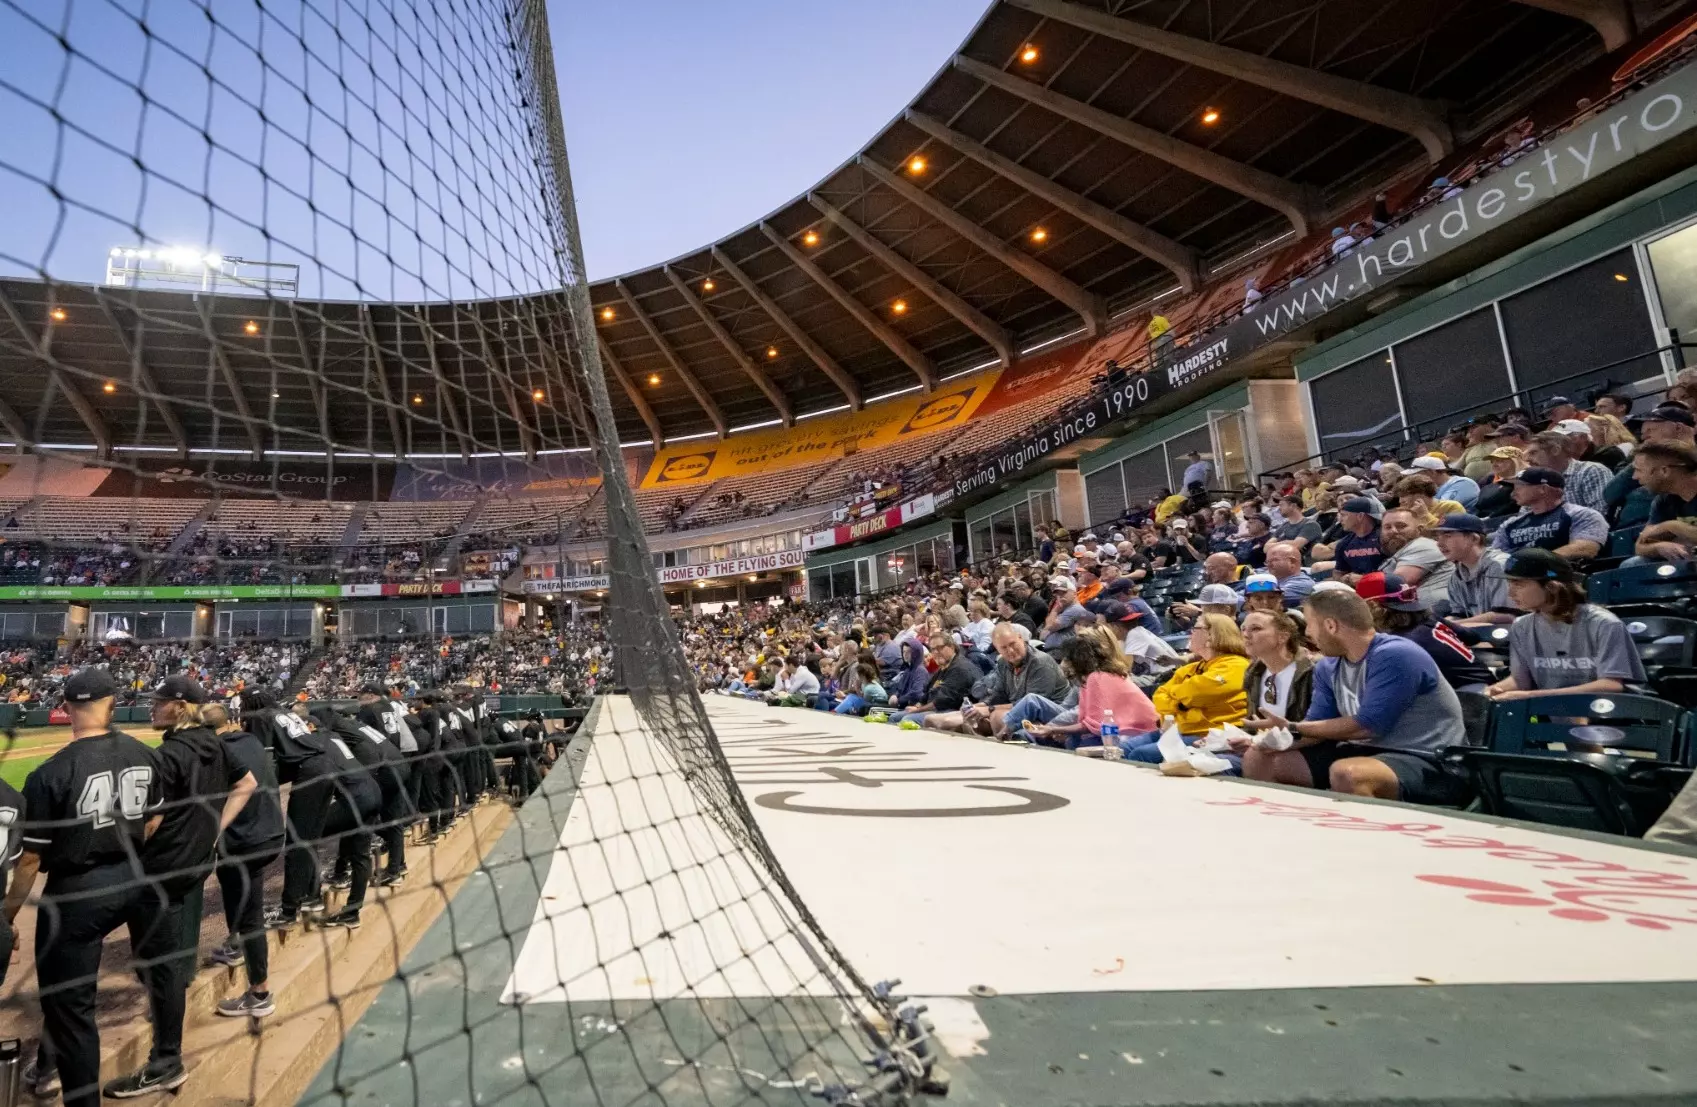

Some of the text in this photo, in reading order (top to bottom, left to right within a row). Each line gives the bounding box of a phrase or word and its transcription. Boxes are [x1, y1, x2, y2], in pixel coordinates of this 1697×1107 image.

[1255, 94, 1683, 335] www.hardestyro
[1168, 339, 1228, 385] HARDESTY
[1178, 360, 1222, 387] ROOFING
[956, 378, 1148, 497] Serving Virginia since 1990
[736, 452, 771, 465] out
[772, 447, 793, 459] of
[797, 441, 828, 453] the
[201, 471, 347, 486] CoStar Group
[850, 514, 887, 538] PARTY DECK
[663, 567, 693, 581] HOME
[697, 566, 710, 577] OF
[714, 562, 735, 575] THE
[738, 555, 776, 572] FLYING
[399, 584, 421, 594] PARTY
[1534, 657, 1596, 670] RIPKEN
[76, 766, 153, 830] 46
